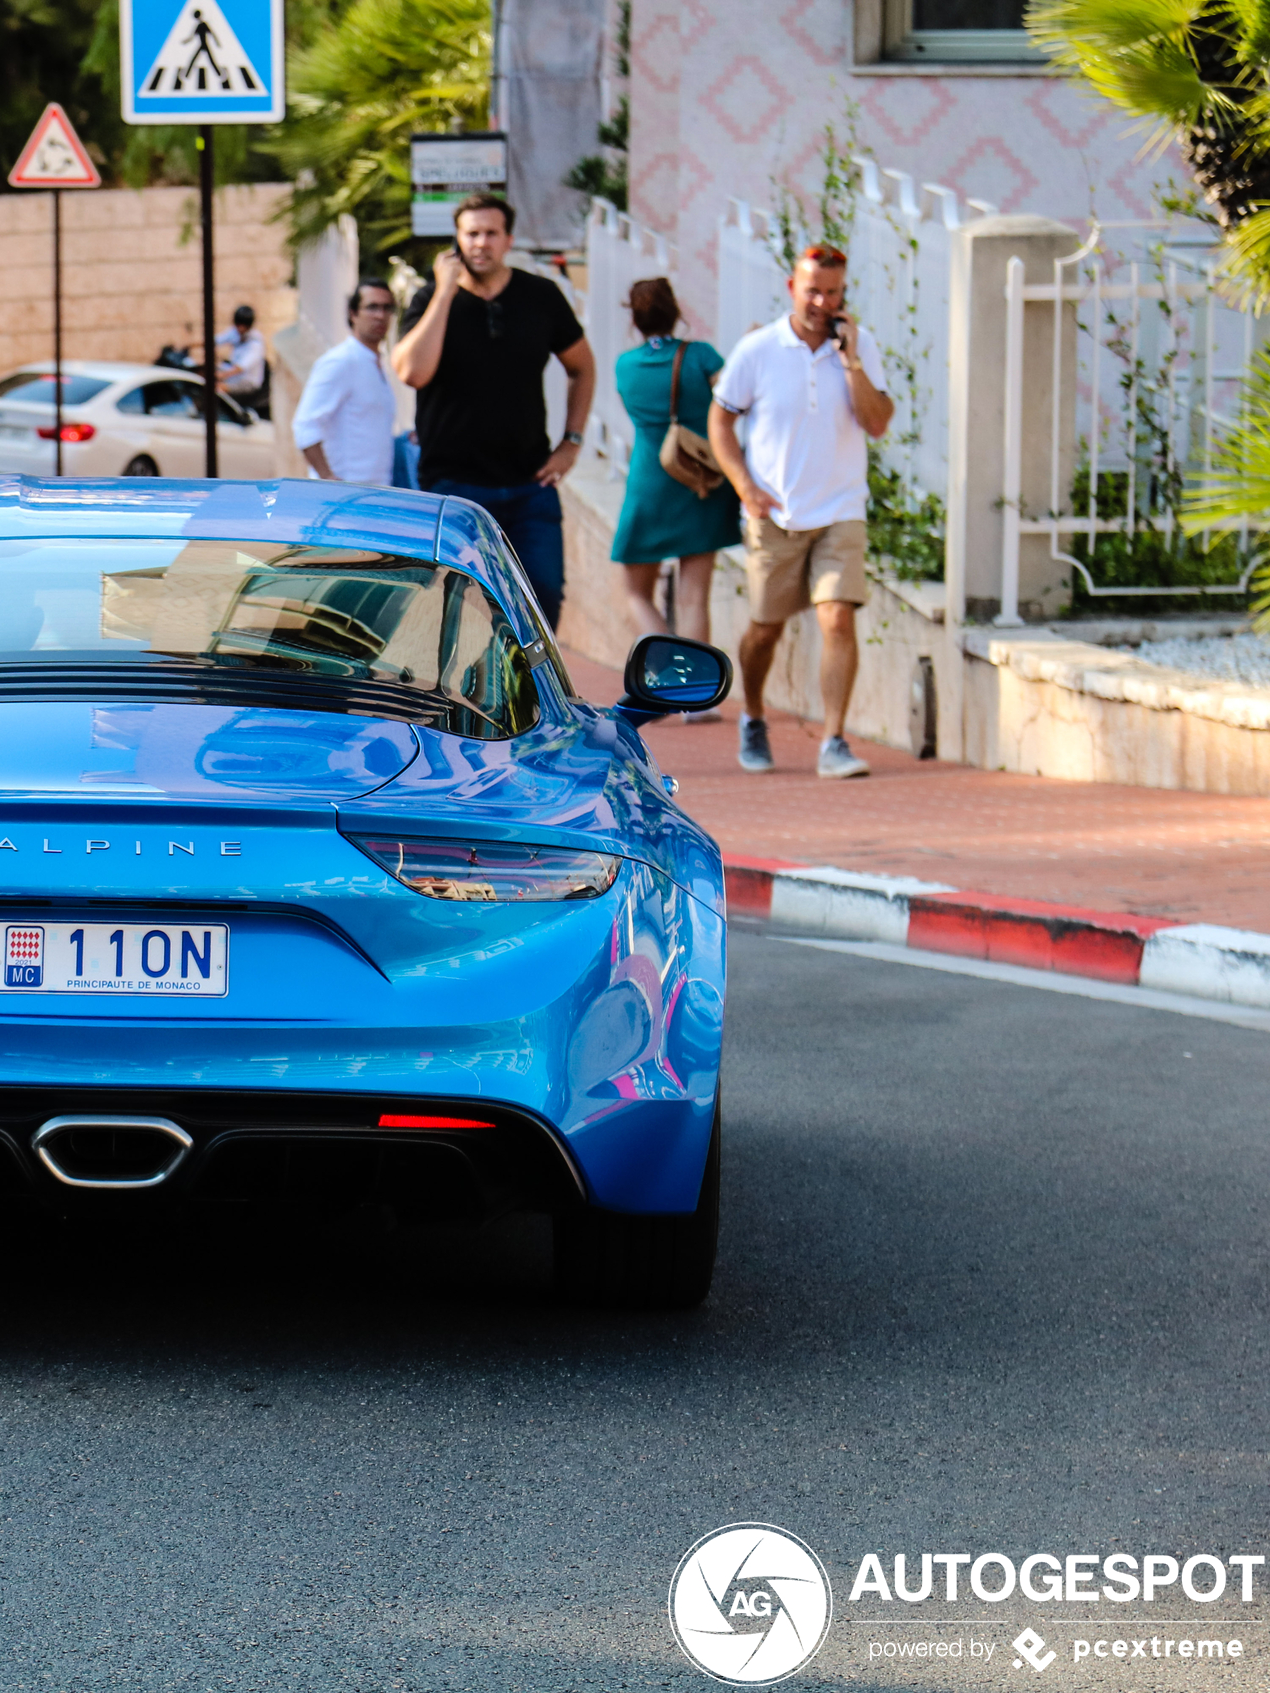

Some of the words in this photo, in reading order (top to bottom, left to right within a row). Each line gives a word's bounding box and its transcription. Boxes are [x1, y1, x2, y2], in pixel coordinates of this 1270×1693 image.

[12, 968, 35, 984] MC
[67, 980, 134, 989] PRINCIPAUTE
[138, 981, 152, 989] DE
[156, 981, 201, 991] MONACO
